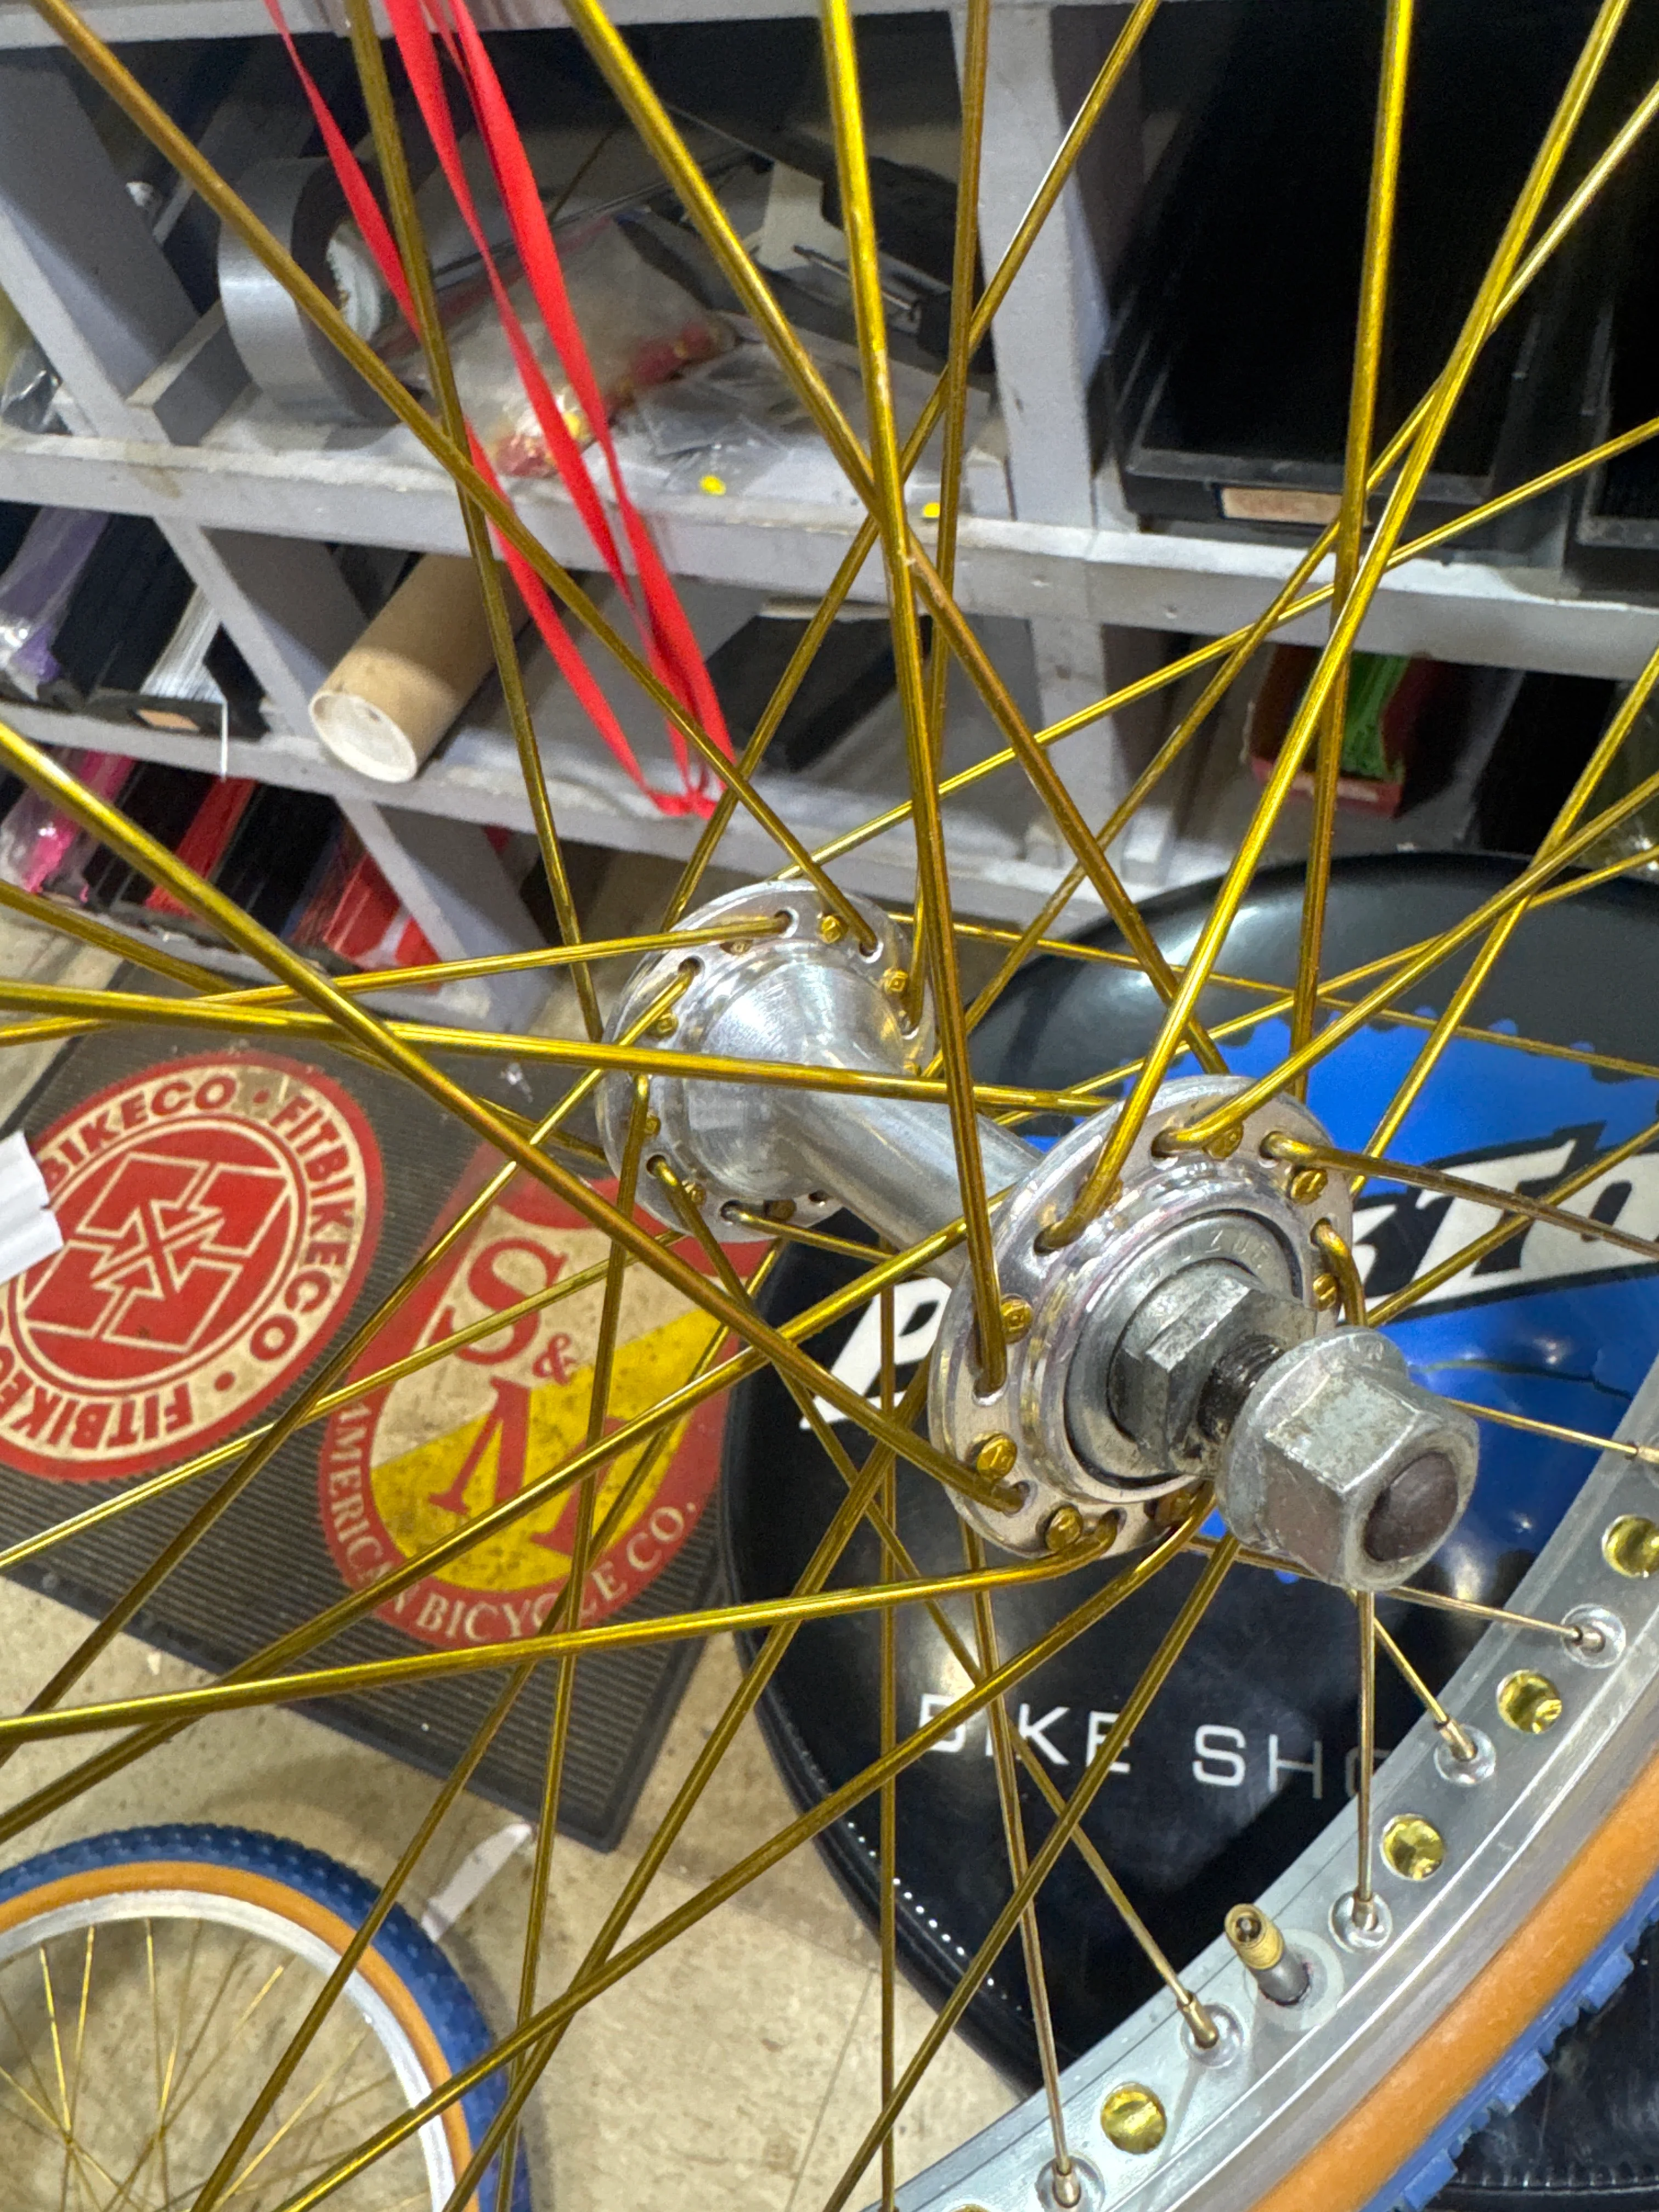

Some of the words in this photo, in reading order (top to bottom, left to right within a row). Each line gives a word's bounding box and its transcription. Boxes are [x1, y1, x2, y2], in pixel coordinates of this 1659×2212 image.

[250, 1096, 357, 1362] FITBIKECO
[0, 1333, 193, 1450] FITBIKE
[626, 1502, 696, 1572] CO.
[918, 1693, 1131, 1774] BIKE
